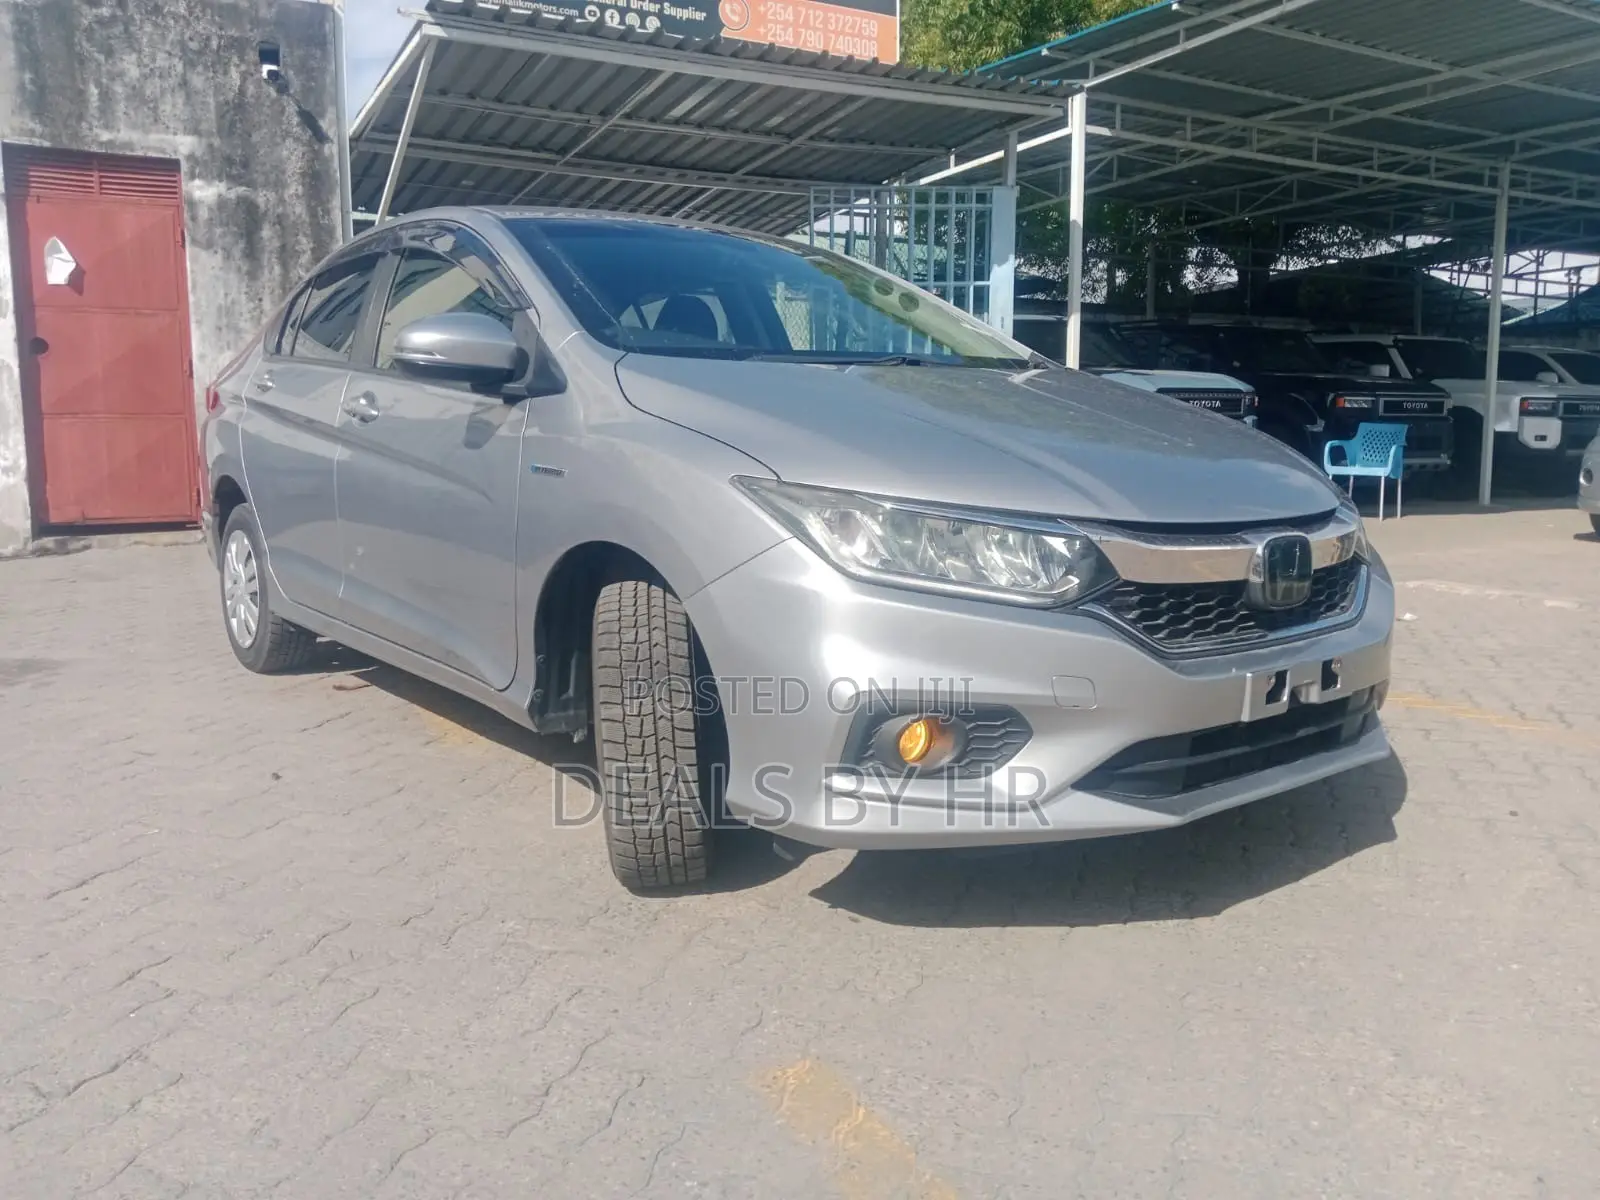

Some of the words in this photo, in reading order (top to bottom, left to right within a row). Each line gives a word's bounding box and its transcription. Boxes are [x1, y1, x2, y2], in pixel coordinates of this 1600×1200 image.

[663, 2, 707, 21] Supplier
[757, 2, 794, 22] +254
[798, 7, 824, 28] 712
[827, 13, 878, 38] 372759
[757, 23, 794, 45] +254
[798, 28, 824, 50] 790
[829, 34, 878, 58] 740308
[1189, 400, 1221, 408] TOYOTA
